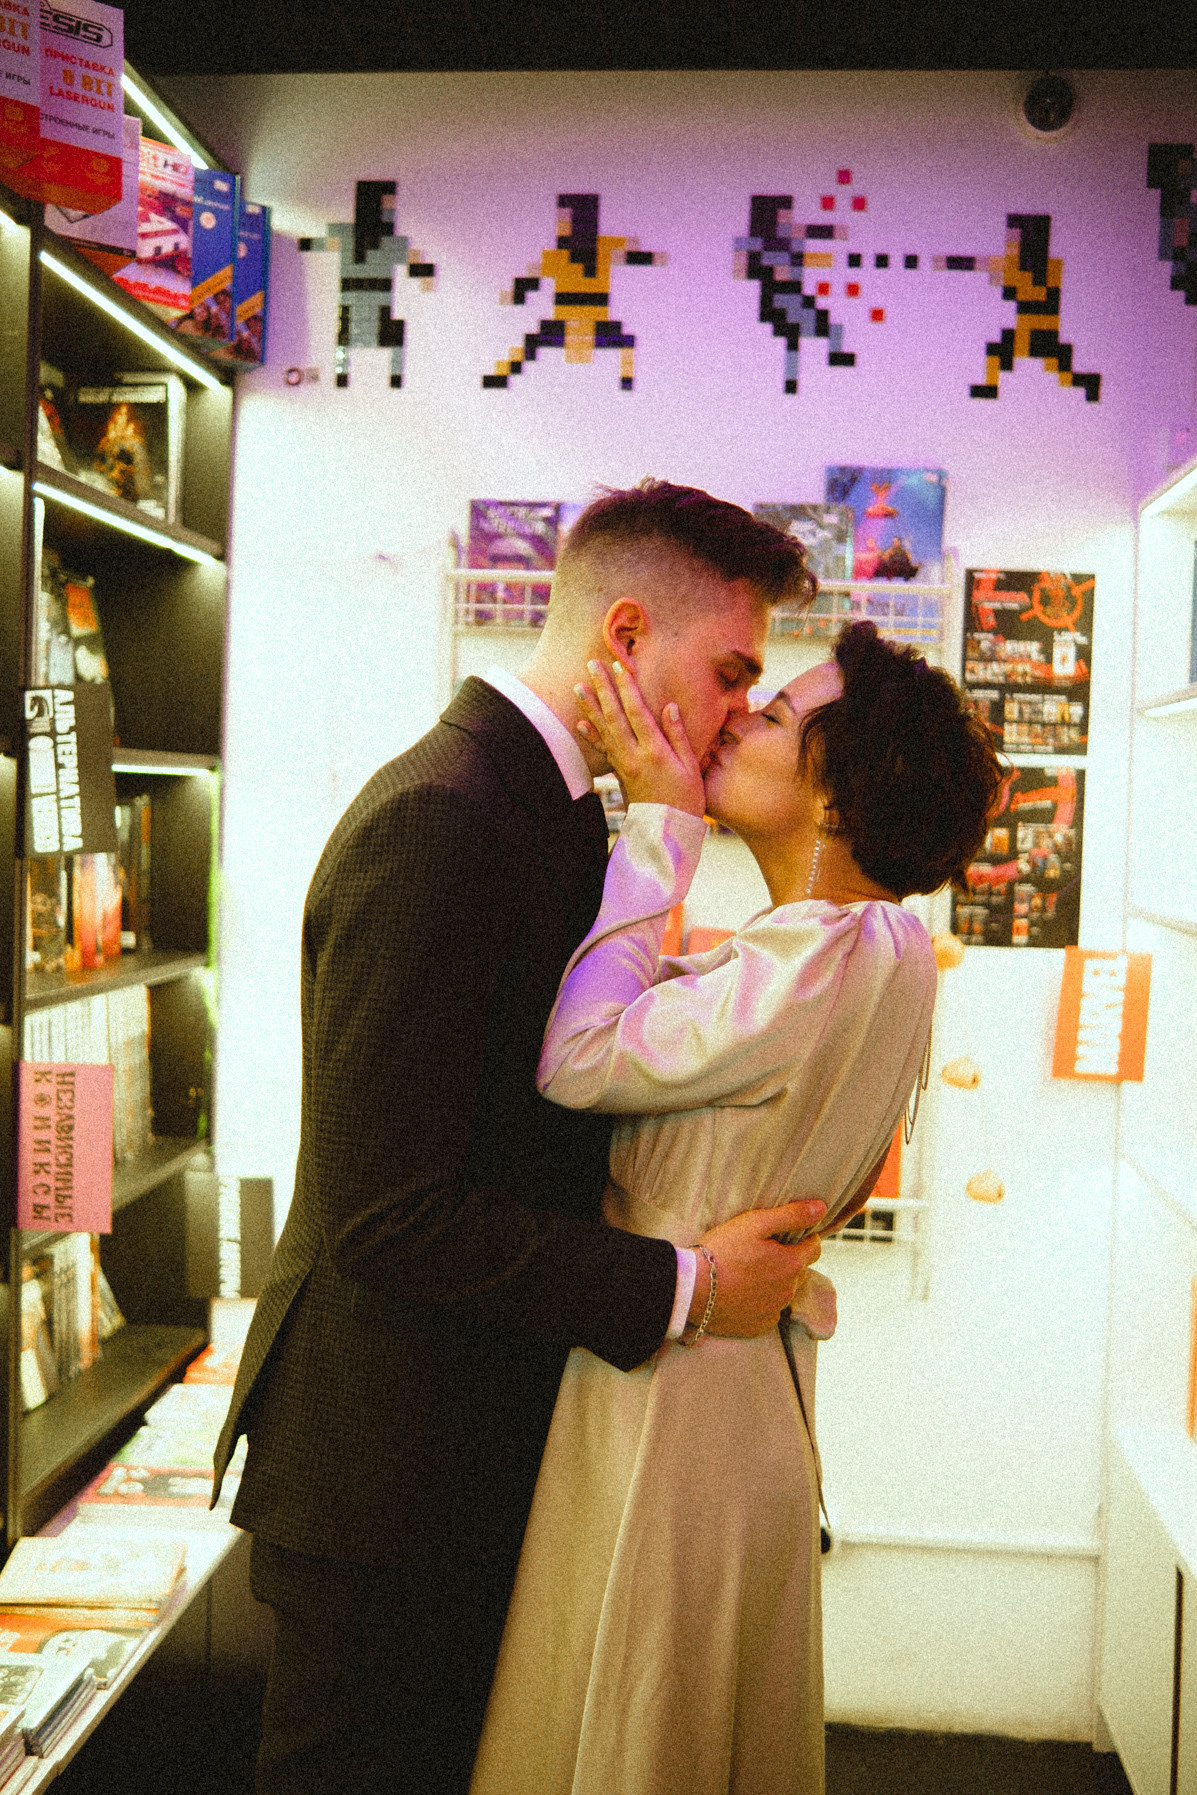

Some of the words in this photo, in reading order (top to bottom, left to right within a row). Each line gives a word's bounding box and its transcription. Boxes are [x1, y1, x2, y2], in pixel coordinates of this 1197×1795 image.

[39, 9, 103, 43] ESIS
[44, 47, 115, 78] ПРИСТАВКА
[49, 84, 116, 113] LASERGUN
[62, 67, 75, 87] 8
[82, 73, 115, 98] BIT
[40, 112, 91, 133] СТРОЕННЫЕ
[55, 689, 84, 852] АЛЬТЕРНАТИВА
[1073, 953, 1128, 1076] MARVEL
[33, 1069, 53, 1221] КОМИКСЫ
[55, 1070, 76, 1224] НЕЗАВИСИМЫЕ
